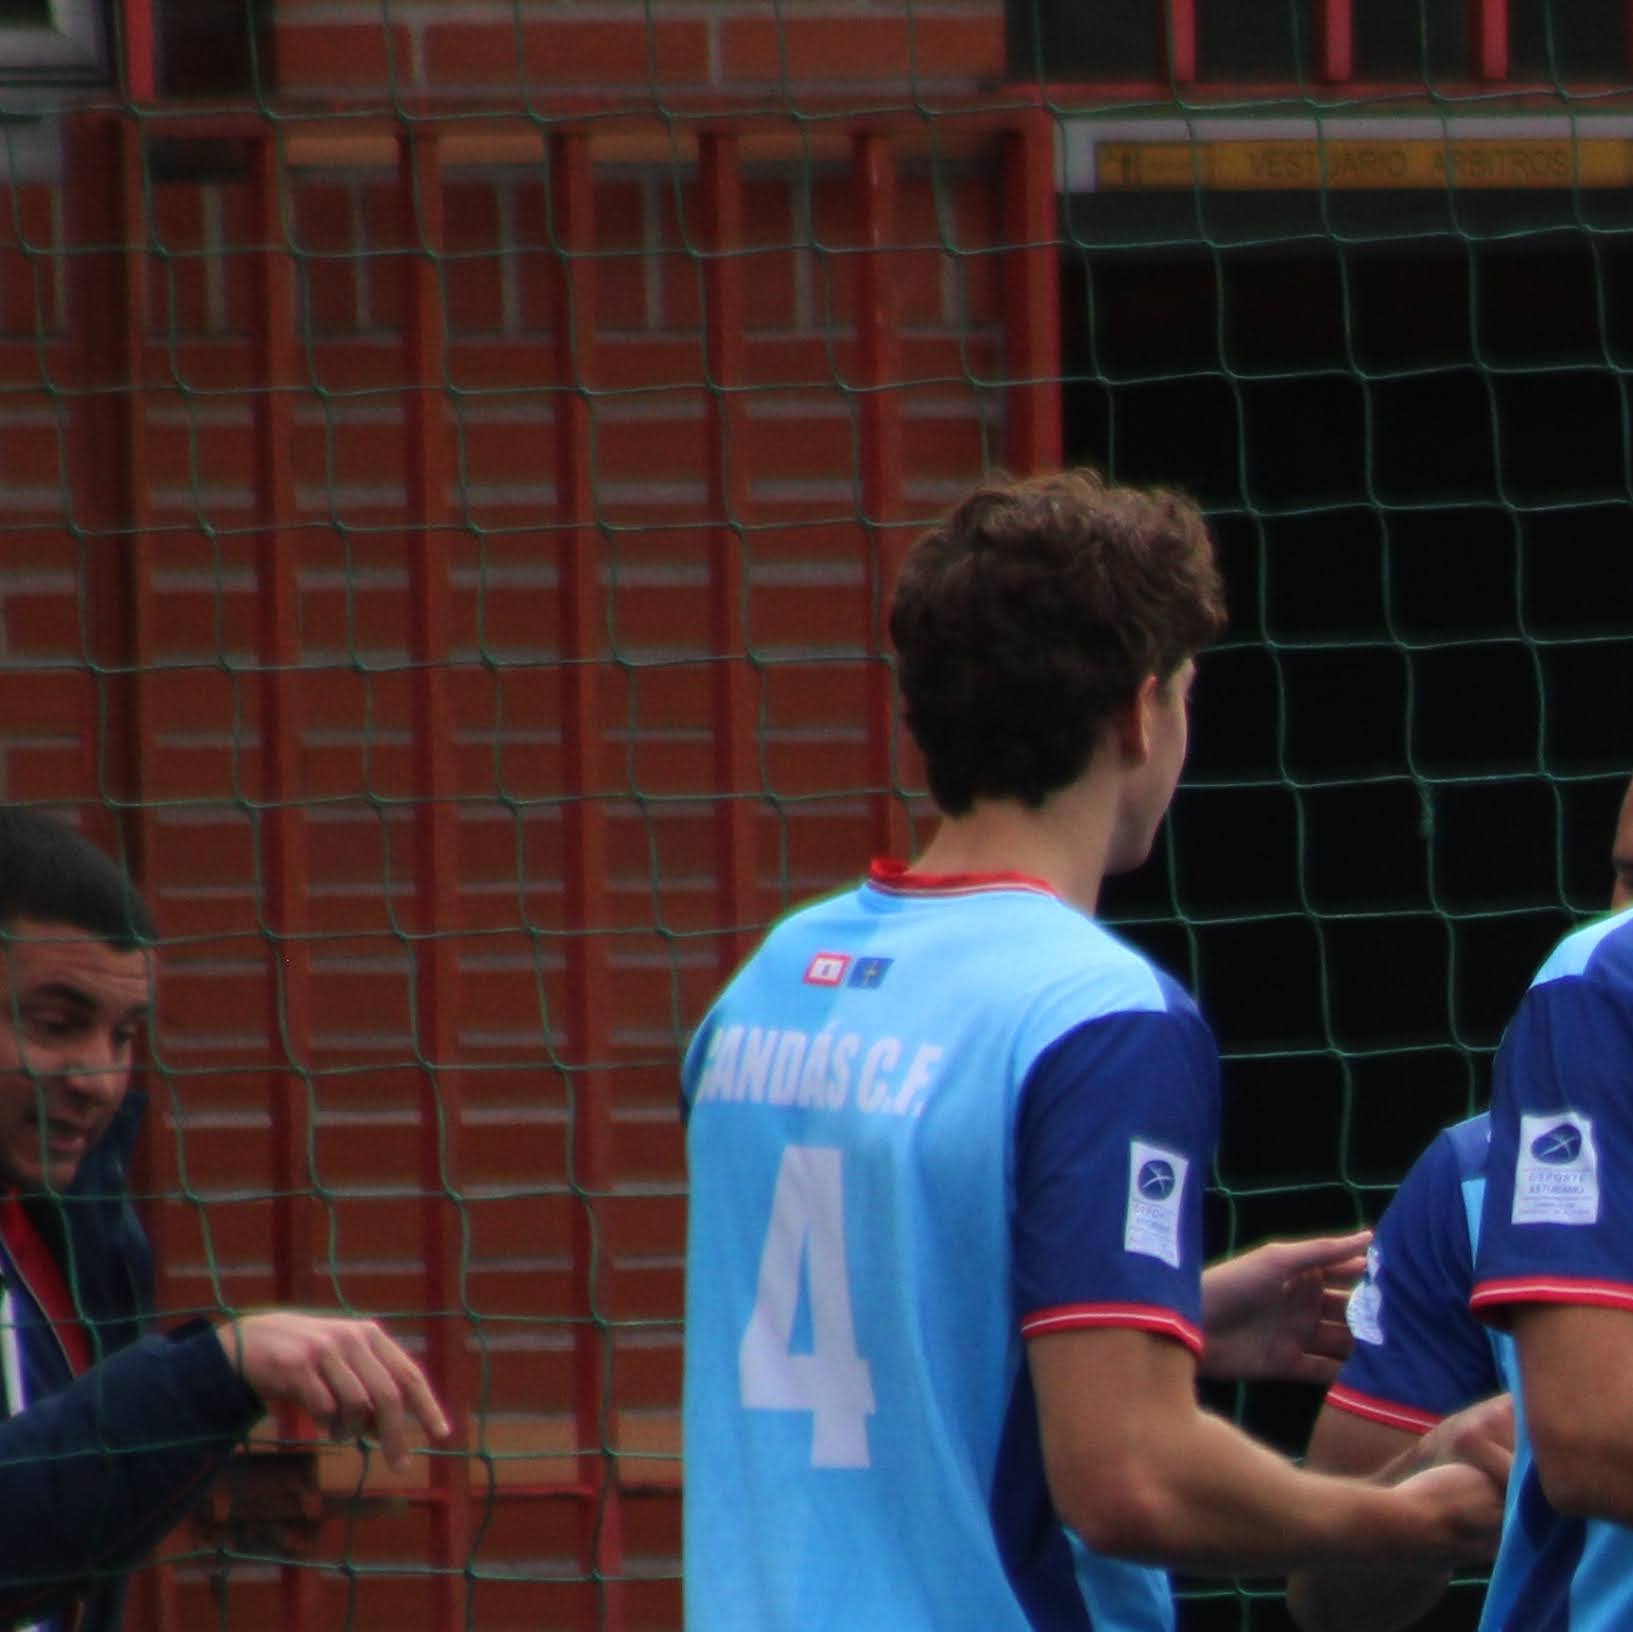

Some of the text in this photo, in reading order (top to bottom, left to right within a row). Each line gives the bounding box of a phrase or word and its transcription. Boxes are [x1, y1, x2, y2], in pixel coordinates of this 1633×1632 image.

[1431, 147, 1568, 178] ARBITROS
[857, 1036, 943, 1117] C.F.
[737, 1145, 875, 1470] 4
